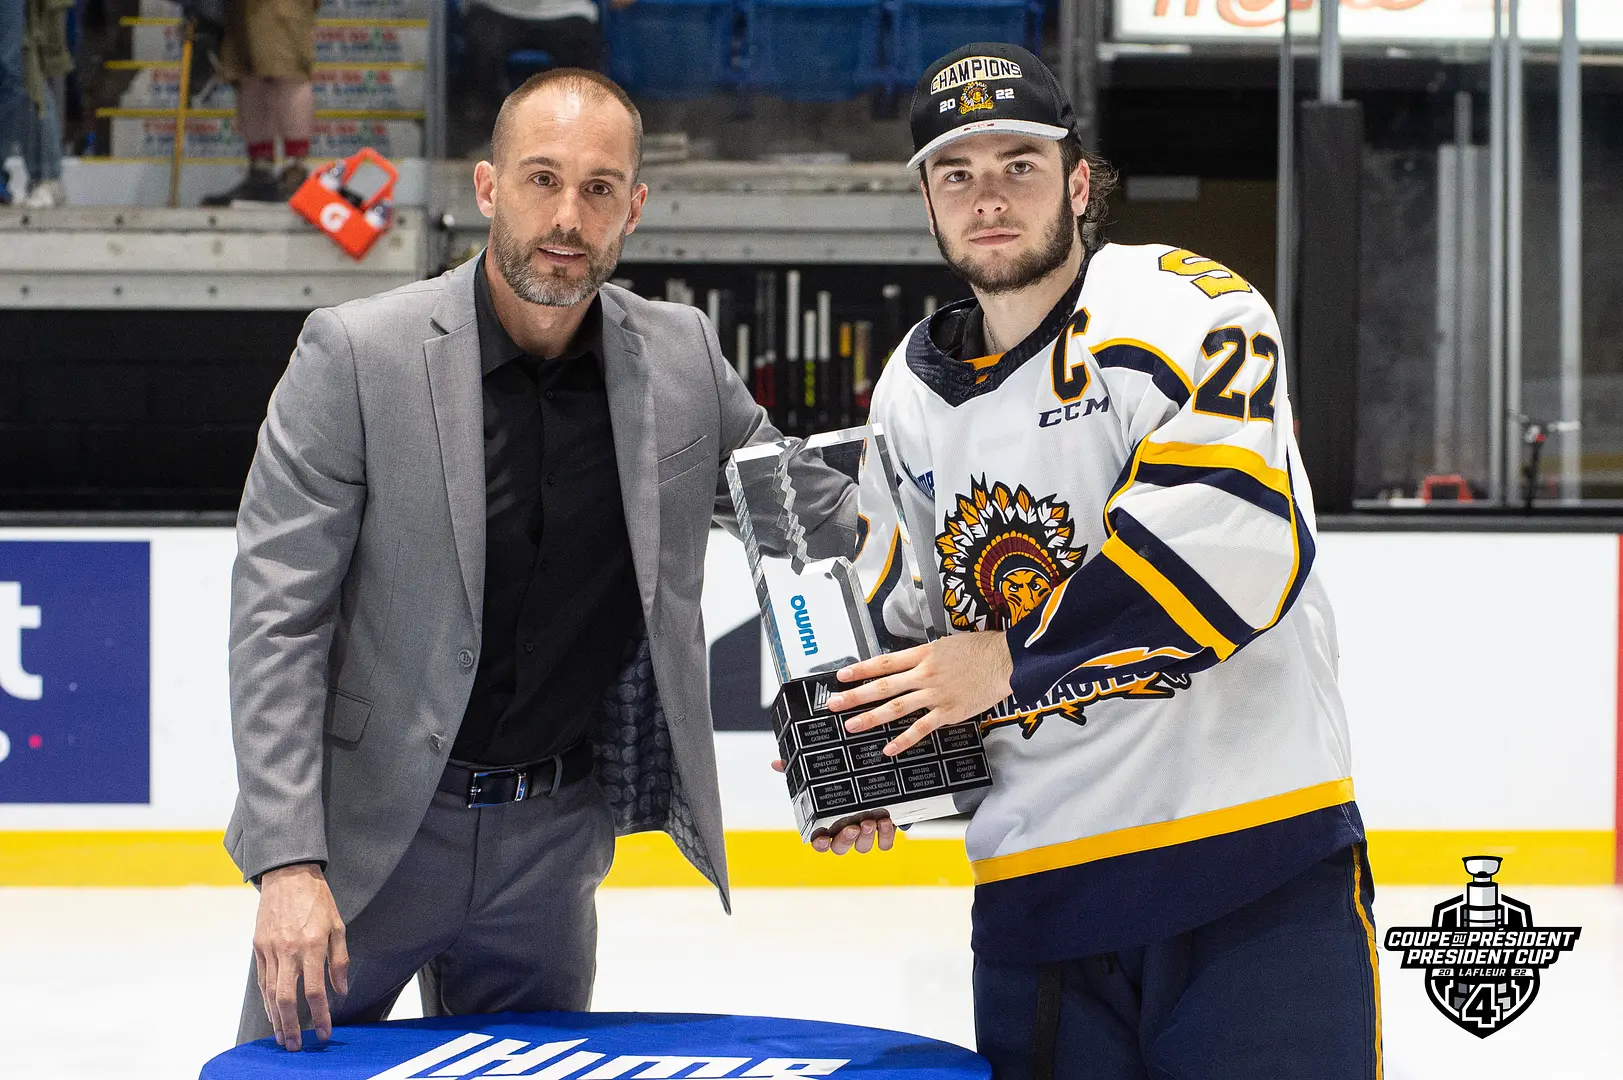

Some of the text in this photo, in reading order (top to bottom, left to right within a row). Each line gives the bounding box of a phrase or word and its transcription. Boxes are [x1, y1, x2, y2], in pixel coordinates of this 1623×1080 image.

[931, 58, 1022, 92] CHAMPIONS
[940, 98, 956, 113] 20
[995, 88, 1015, 100] 22
[319, 203, 352, 233] G
[1050, 306, 1091, 404] C
[1192, 325, 1279, 425] 22
[1038, 395, 1110, 428] CCM
